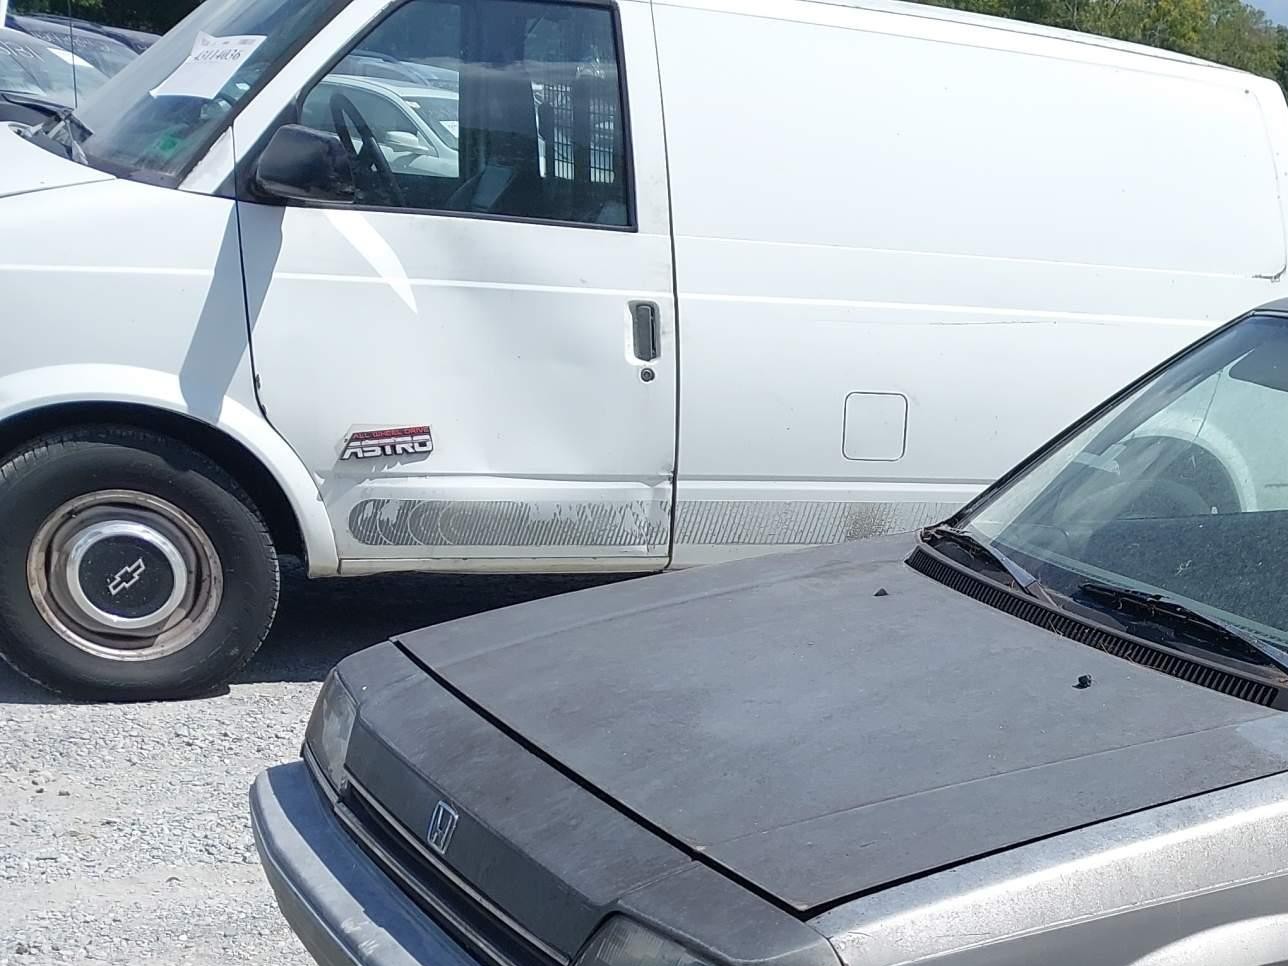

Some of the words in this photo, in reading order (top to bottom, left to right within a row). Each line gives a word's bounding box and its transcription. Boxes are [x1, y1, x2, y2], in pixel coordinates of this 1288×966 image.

[352, 432, 371, 440] ALL
[372, 428, 403, 438] WHEEL
[403, 425, 431, 435] DRIVE
[342, 434, 433, 460] ASTRO
